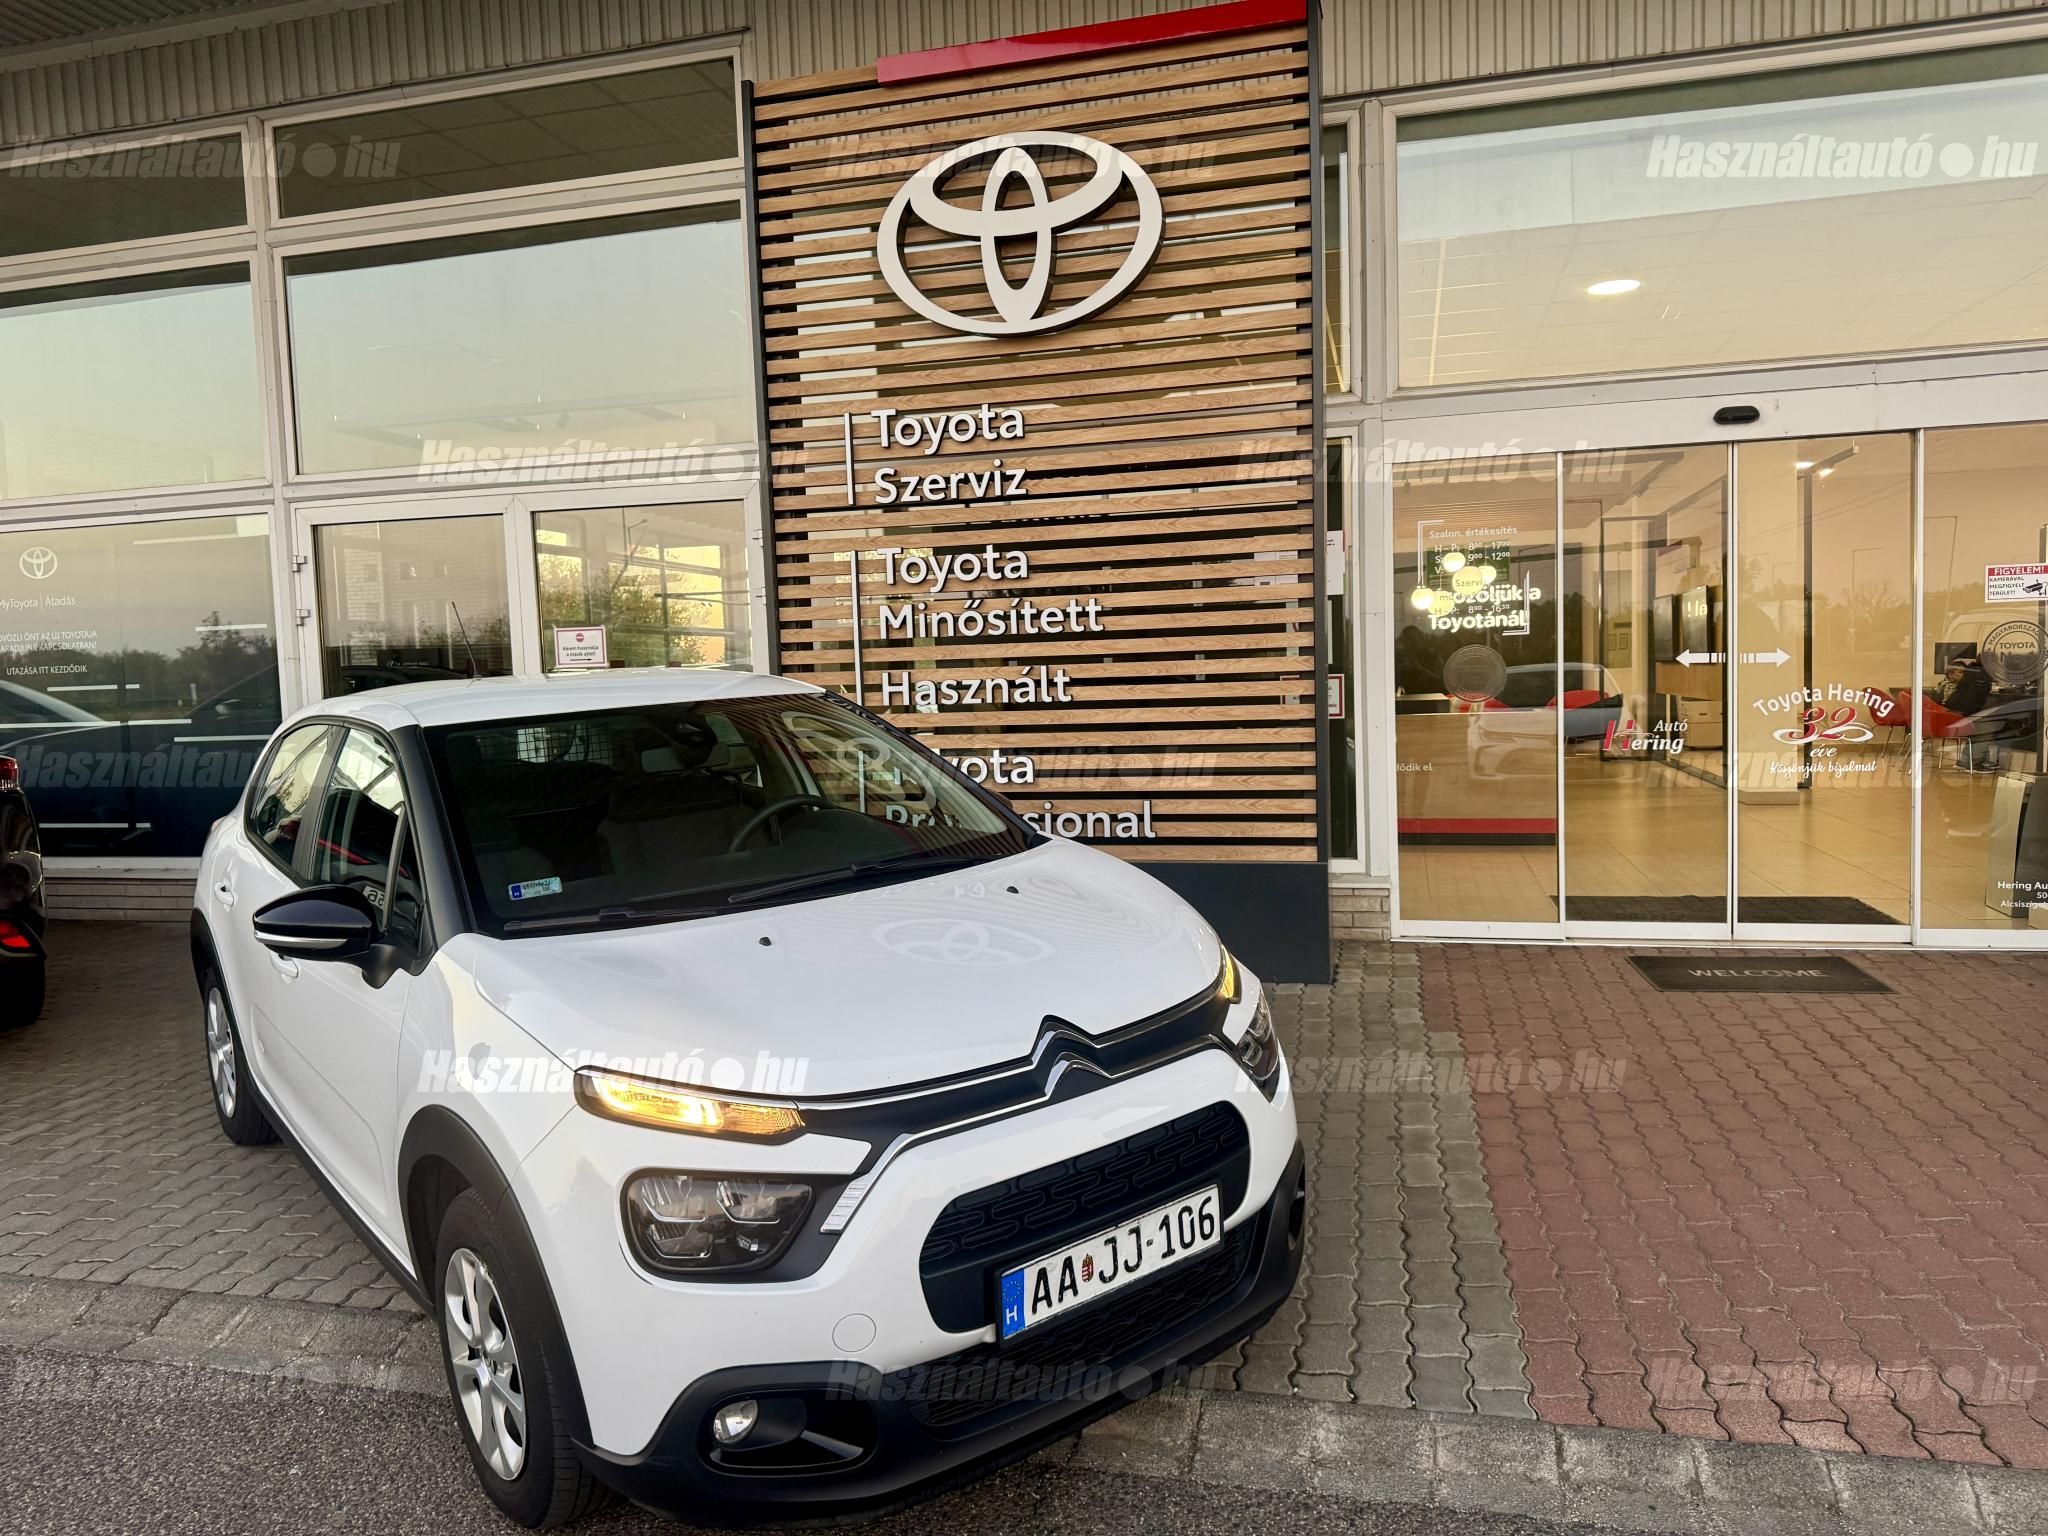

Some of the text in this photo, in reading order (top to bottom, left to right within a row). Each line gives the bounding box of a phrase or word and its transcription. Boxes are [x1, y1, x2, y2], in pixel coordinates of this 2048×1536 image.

[871, 404, 1025, 455] Toyota
[874, 458, 1028, 504] Szerviz
[877, 544, 1029, 593] Toyota
[1994, 566, 2045, 576] FIGYELEM!
[1455, 579, 1484, 587] Szervi
[878, 597, 1104, 640] Minősített
[1999, 641, 2036, 650] TOYOTA
[881, 664, 1072, 706] Használt
[1752, 683, 1895, 718] Toyota Hering
[1653, 718, 1688, 732] Autó
[1809, 744, 1838, 758] éve
[1997, 880, 2032, 892] Hering
[1688, 968, 1827, 978] WELCOME
[1005, 1304, 1019, 1326] H
